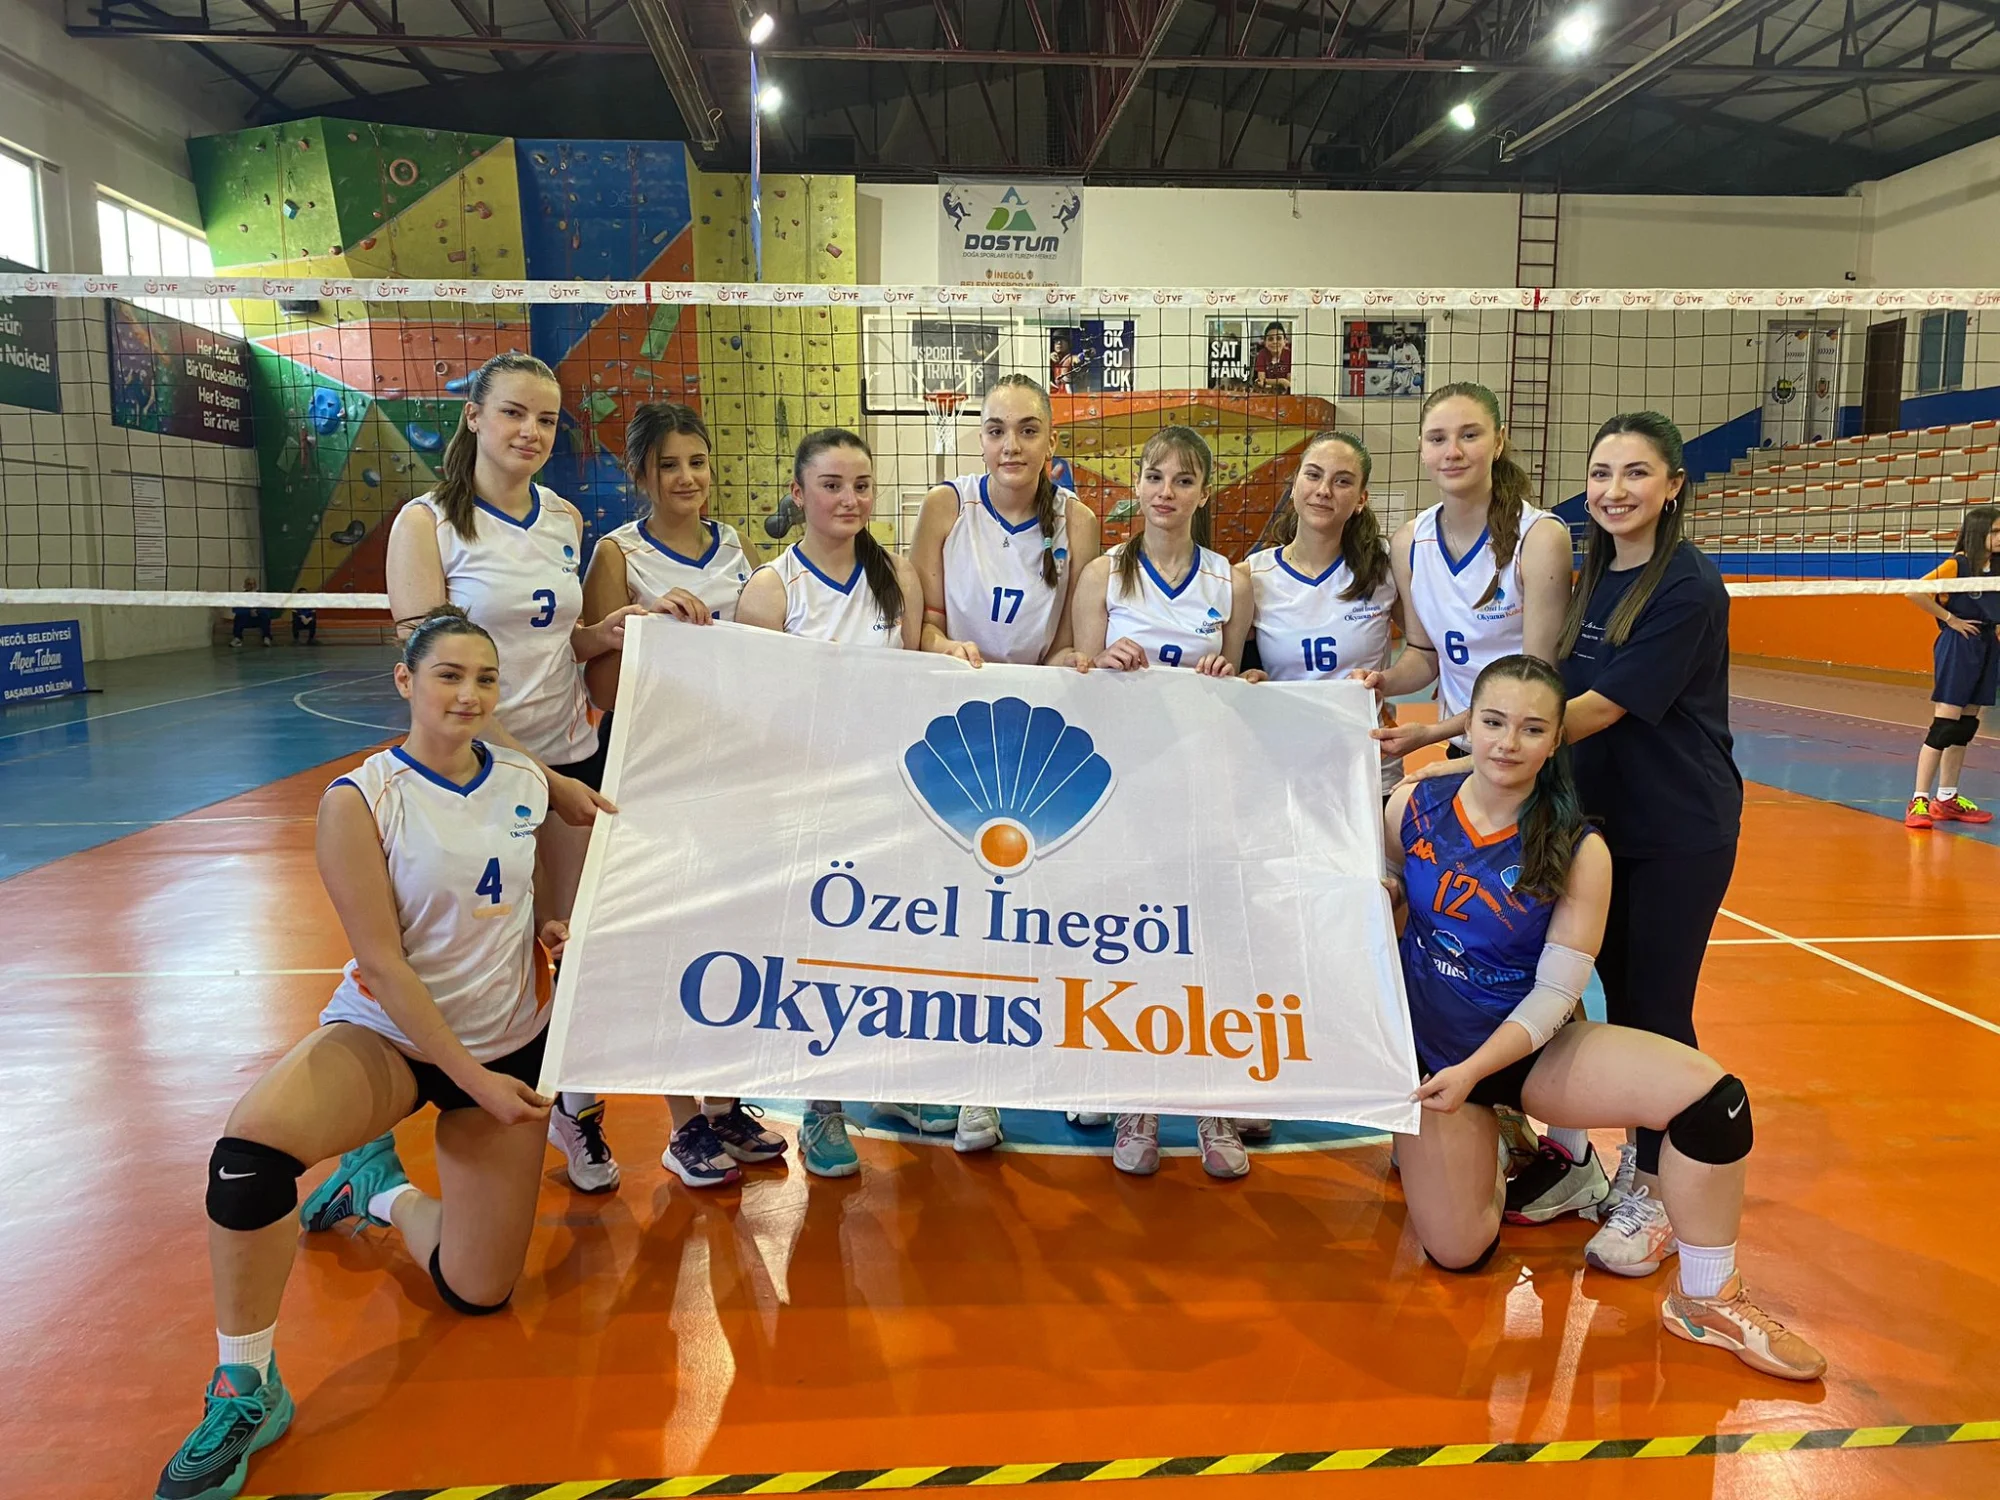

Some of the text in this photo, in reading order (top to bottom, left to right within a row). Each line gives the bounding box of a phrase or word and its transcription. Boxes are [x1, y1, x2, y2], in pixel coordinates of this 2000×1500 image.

[964, 234, 1060, 252] DOSTUM
[994, 270, 1026, 280] İNEGÖL
[100, 282, 118, 290] TVF
[159, 283, 178, 292] TVF
[219, 284, 236, 293] TVF
[276, 285, 294, 294] TVF
[334, 286, 352, 294] TVF
[392, 286, 410, 295] TVF
[449, 287, 467, 296] TVF
[506, 288, 524, 297] TVF
[562, 288, 580, 297] TVF
[619, 289, 636, 298] TVF
[675, 290, 692, 298] TVF
[731, 290, 748, 300] TVF
[786, 292, 804, 300] TVF
[842, 292, 859, 300] TVF
[897, 292, 914, 301] TVF
[951, 292, 968, 301] TVF
[1005, 293, 1022, 302] TVF
[1060, 294, 1076, 302] TVF
[1112, 294, 1129, 302] TVF
[1166, 294, 1183, 302] TVF
[1219, 294, 1236, 303] TVF
[1272, 294, 1288, 303] TVF
[1324, 294, 1341, 303] TVF
[1376, 295, 1393, 304] TVF
[1430, 295, 1446, 304] TVF
[1482, 296, 1498, 304] TVF
[1584, 296, 1600, 304] TVF
[1636, 296, 1652, 304] TVF
[1687, 296, 1703, 304] TVF
[1788, 296, 1804, 304] TVF
[196, 338, 212, 357] Her
[1103, 330, 1124, 348] OK
[1211, 341, 1239, 358] SAT
[5, 343, 51, 374] Nokta!
[185, 359, 198, 377] Bir
[1211, 361, 1250, 382] RANÇ
[198, 386, 214, 405] Her
[203, 410, 215, 428] Bir
[530, 589, 556, 628] 3
[991, 586, 1025, 624] 17
[27, 627, 72, 644] BELEDİYESİ
[1158, 644, 1183, 667] 9
[1301, 636, 1338, 672] 16
[1445, 630, 1469, 665] 6
[4, 678, 73, 700] BAŞARILAR DİLERİM
[475, 857, 502, 904] 4
[1431, 868, 1480, 922] 12
[809, 860, 1195, 965] Özel İnegöl
[679, 950, 1313, 1082] Okyanus Koleji
